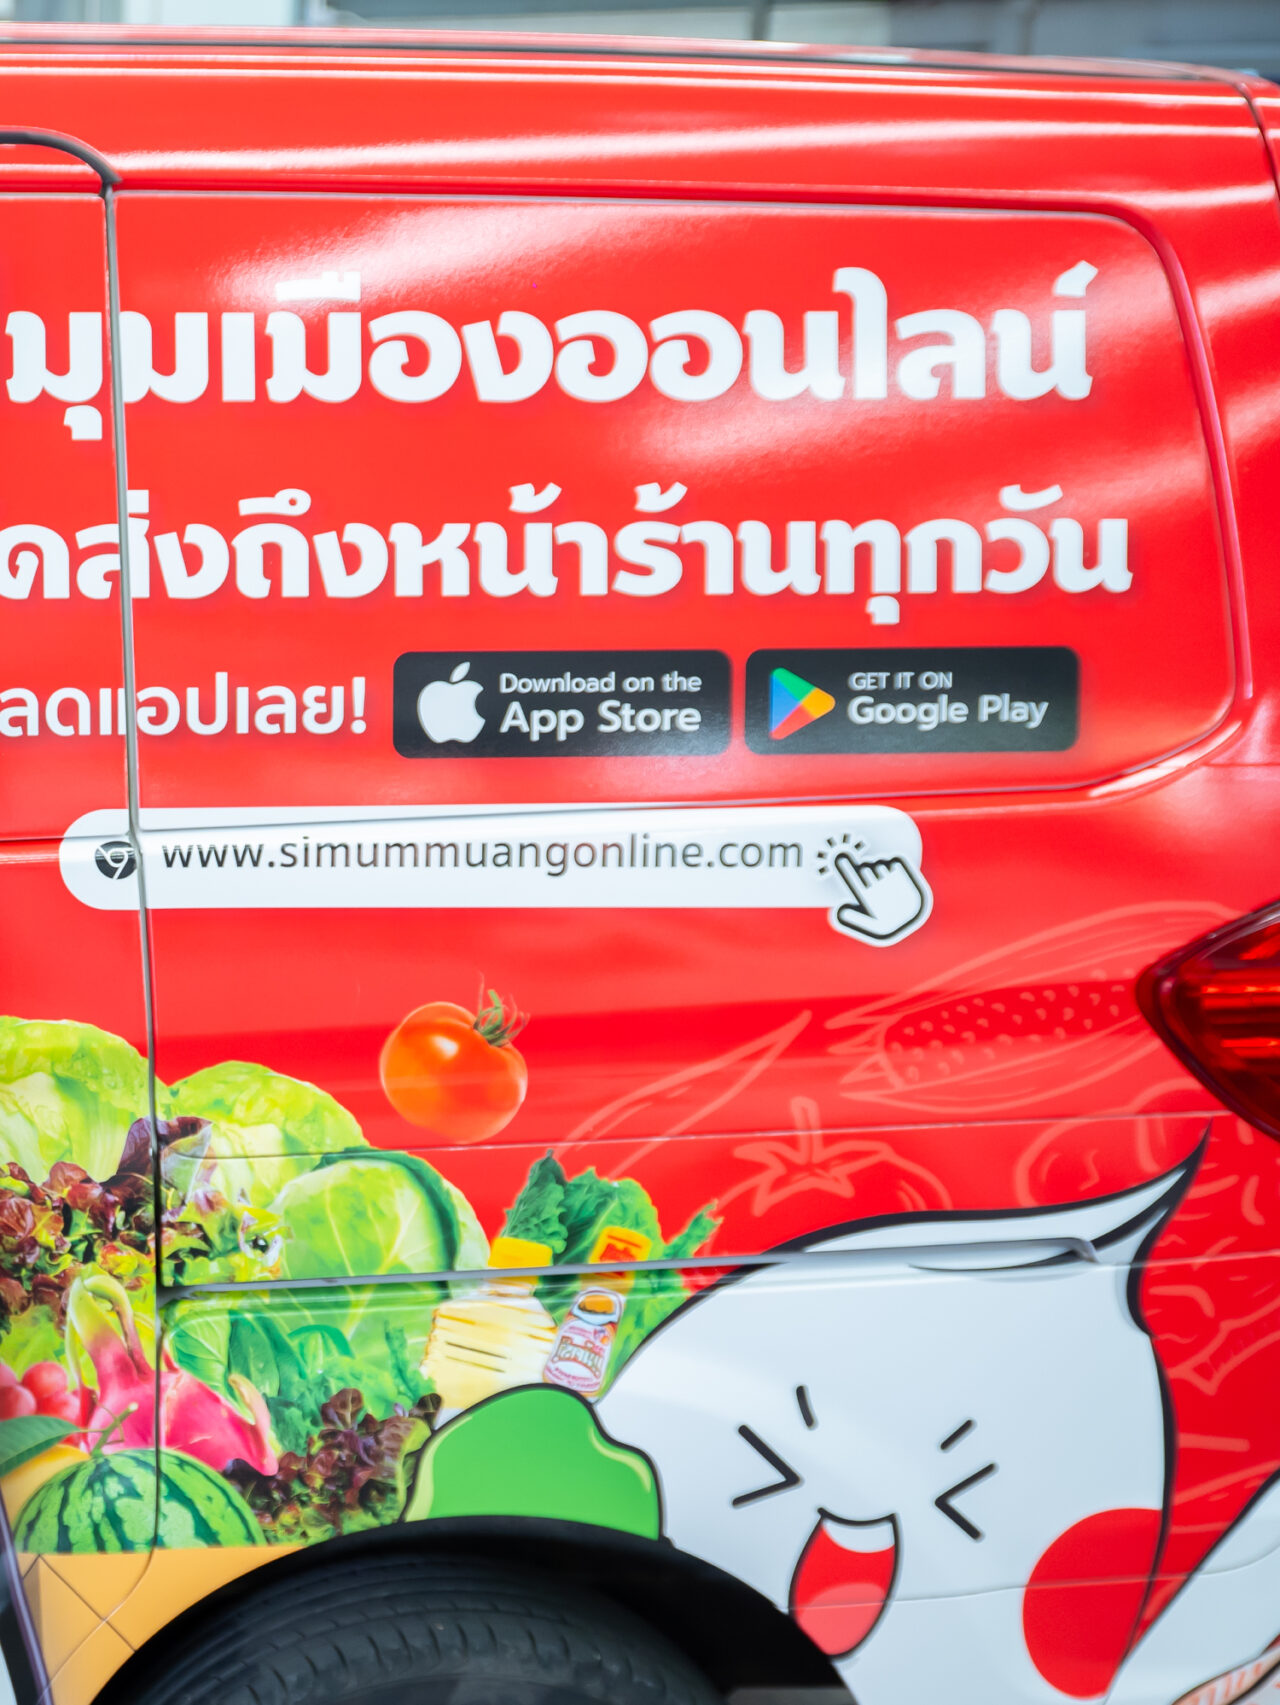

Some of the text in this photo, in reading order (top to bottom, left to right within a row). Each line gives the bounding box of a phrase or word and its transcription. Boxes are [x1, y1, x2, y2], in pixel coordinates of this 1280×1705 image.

[499, 670, 703, 694] Download on the
[848, 671, 953, 691] GET IT ON
[499, 699, 702, 742] App Store
[846, 692, 1050, 731] Google Play
[161, 831, 805, 877] www.simummuangonline.com
